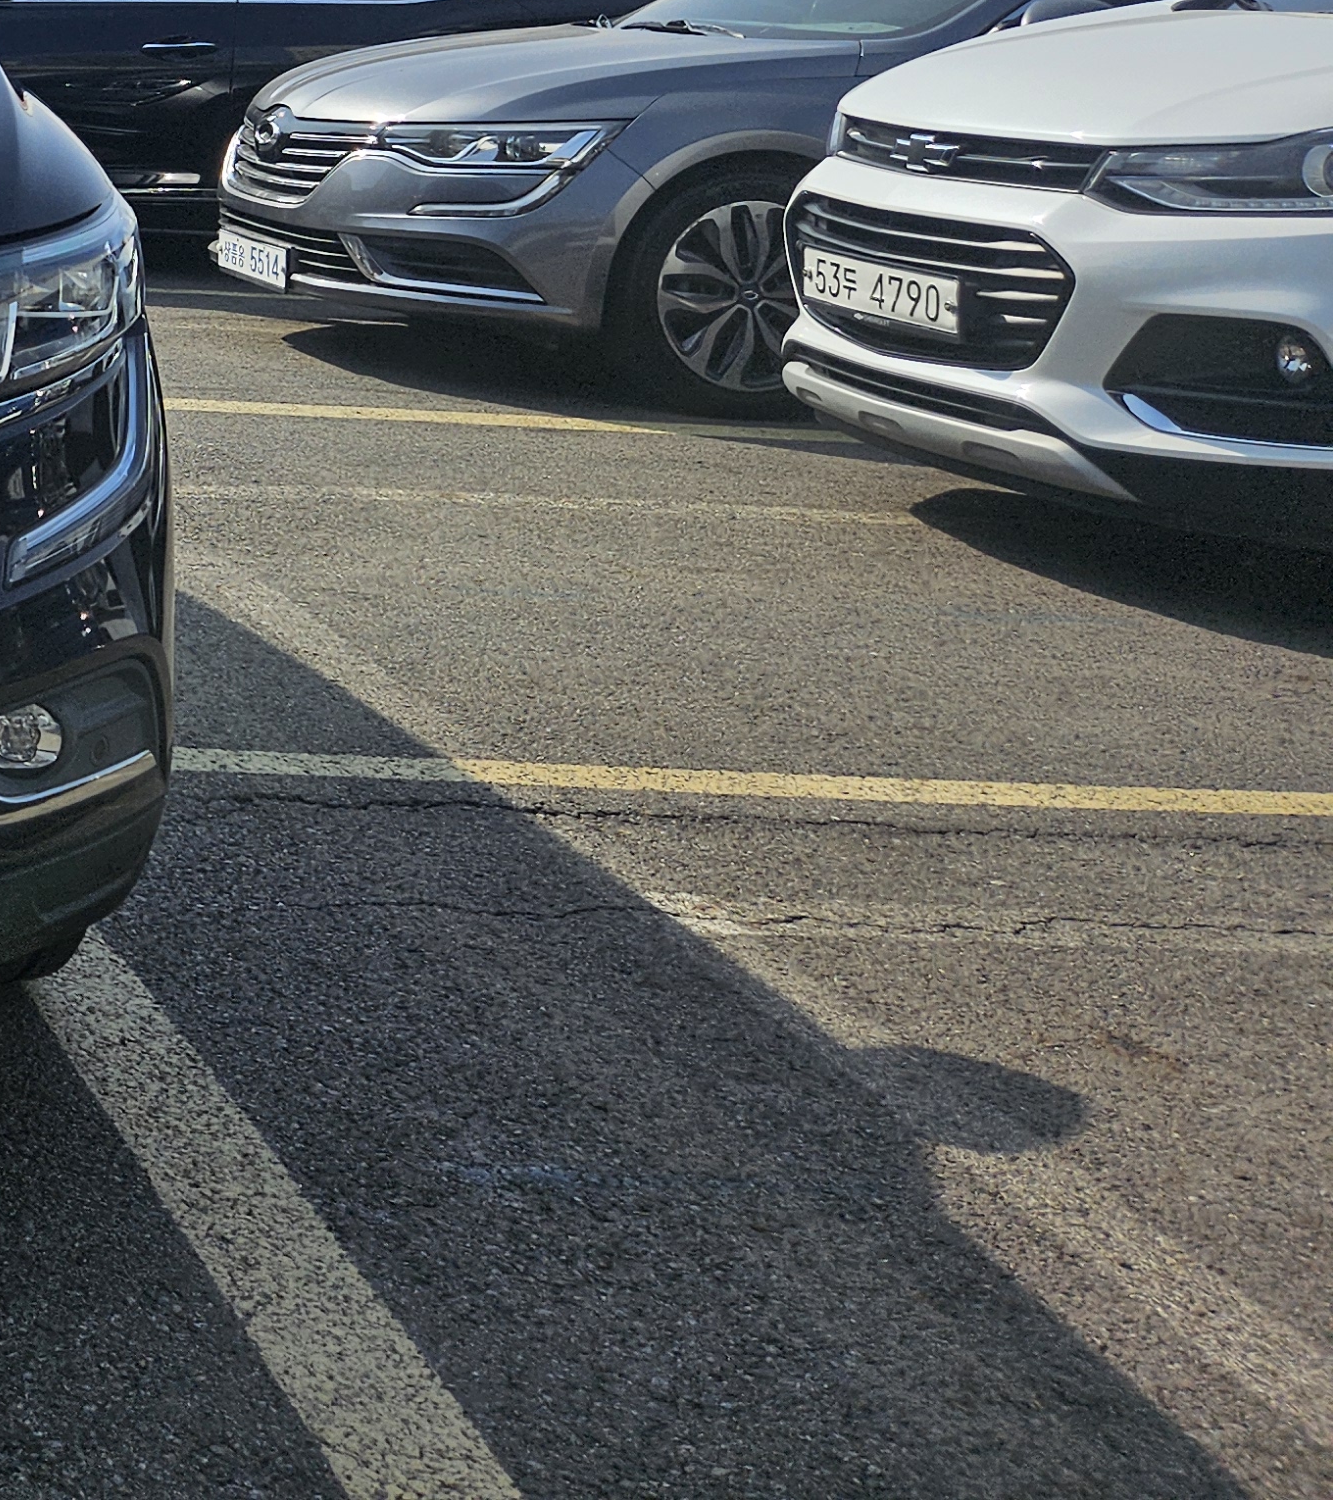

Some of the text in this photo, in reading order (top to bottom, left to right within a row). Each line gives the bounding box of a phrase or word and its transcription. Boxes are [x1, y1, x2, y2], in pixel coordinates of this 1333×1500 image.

[250, 245, 280, 280] 5514
[814, 257, 940, 323] 53두 4790
